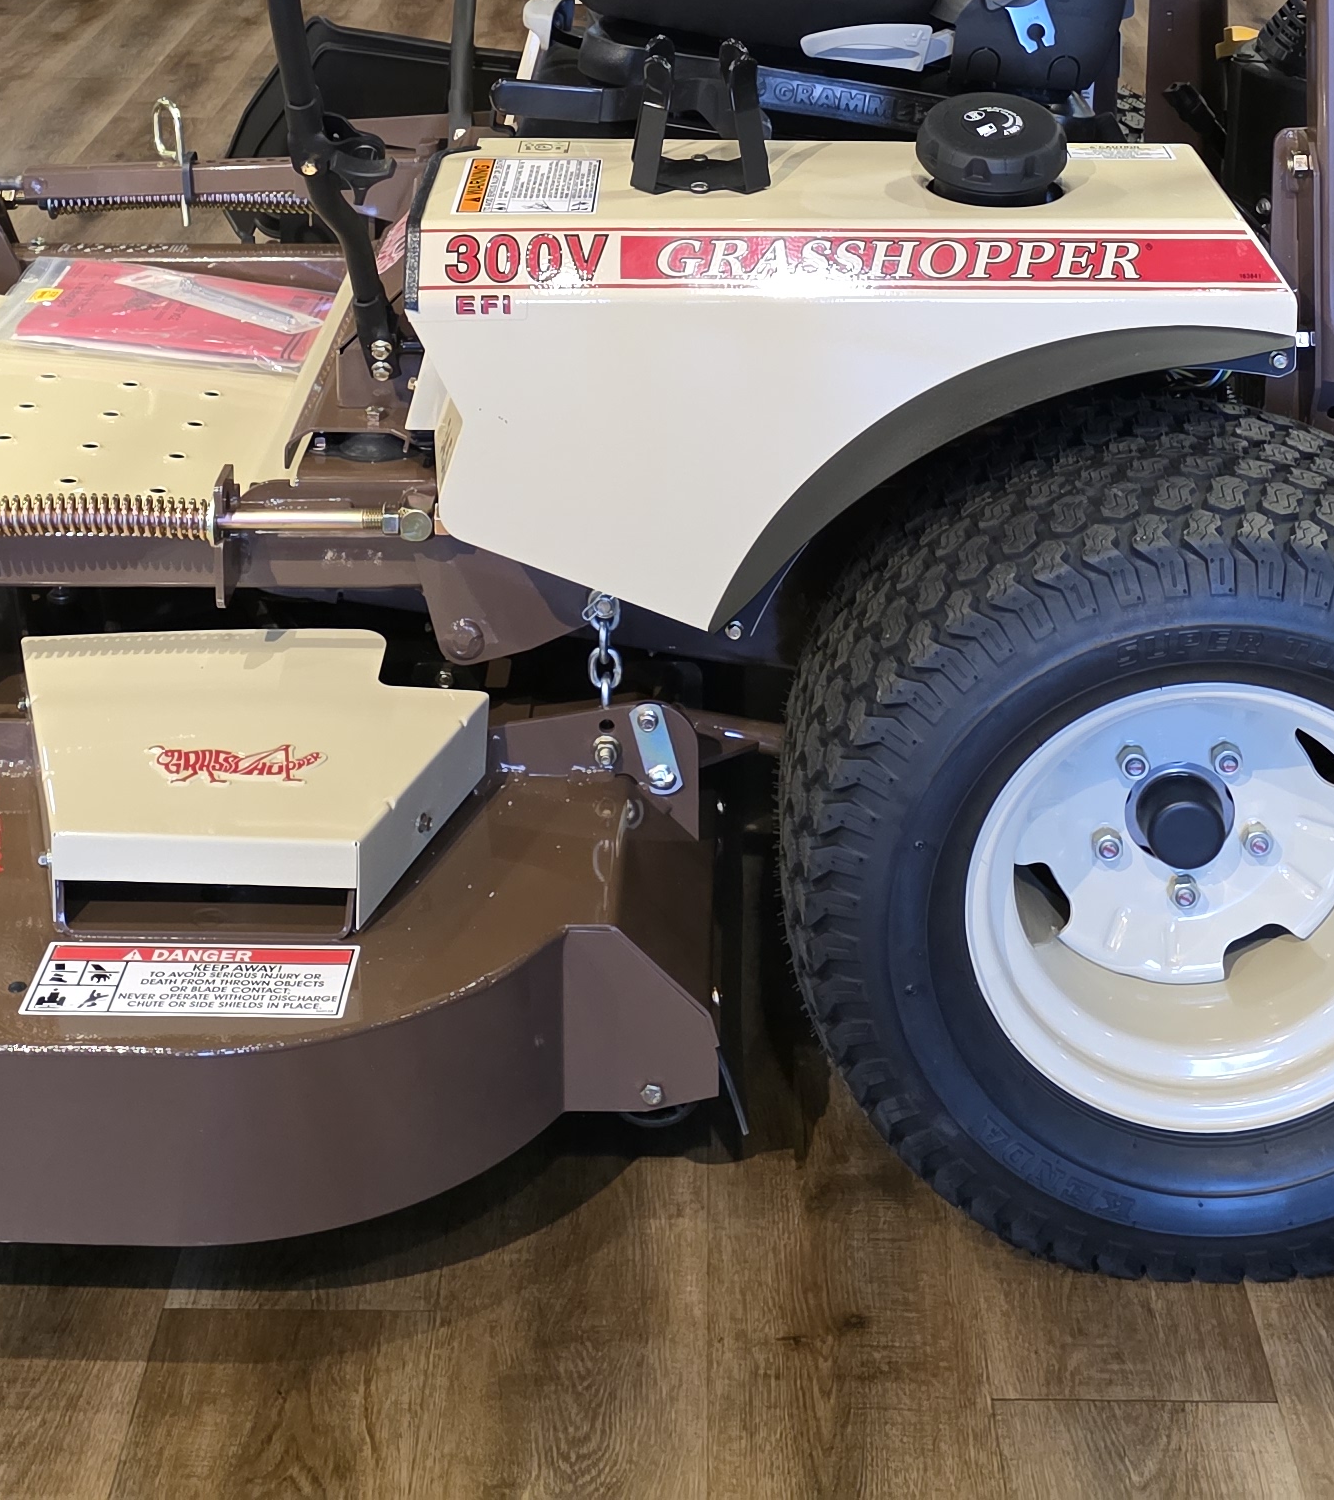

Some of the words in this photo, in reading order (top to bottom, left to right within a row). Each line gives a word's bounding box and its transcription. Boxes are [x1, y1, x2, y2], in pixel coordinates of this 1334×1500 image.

[467, 164, 490, 196] WARNING
[445, 233, 609, 283] 300V
[655, 238, 1142, 280] GRASSHOPPER
[1118, 629, 1264, 667] SUPER
[151, 950, 253, 962] DANGER
[192, 964, 229, 972] KEEP
[233, 964, 282, 973] AWAY!
[220, 979, 270, 987] THROWN
[274, 980, 325, 988] OBJECTS
[160, 993, 210, 1001] OPERATE
[282, 1002, 322, 1010] PLACE.
[979, 1114, 1137, 1222] KENDA
